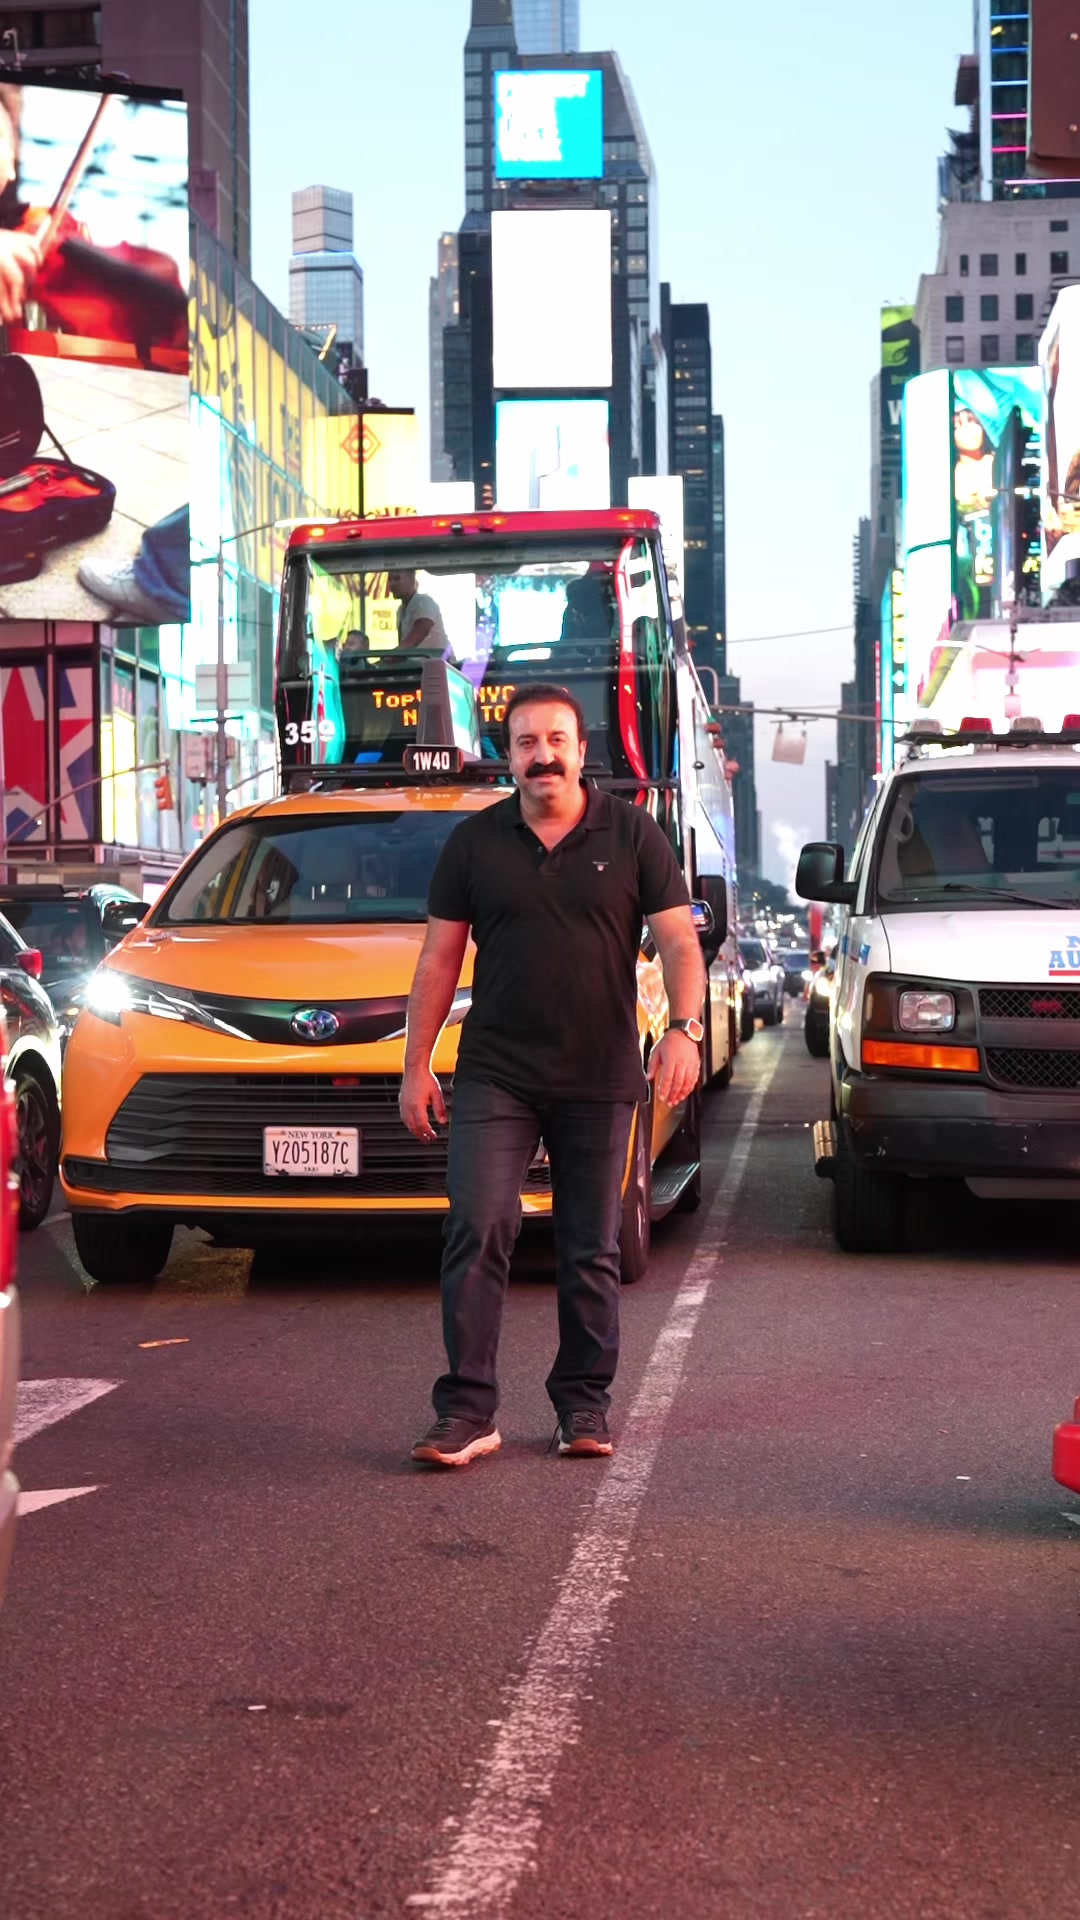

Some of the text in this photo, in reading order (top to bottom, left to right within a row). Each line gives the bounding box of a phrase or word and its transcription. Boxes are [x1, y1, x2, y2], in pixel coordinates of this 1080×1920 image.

[285, 720, 336, 745] 359
[413, 751, 450, 771] 1W40
[288, 1130, 334, 1139] NEW YORK
[272, 1140, 349, 1165] Y205187C
